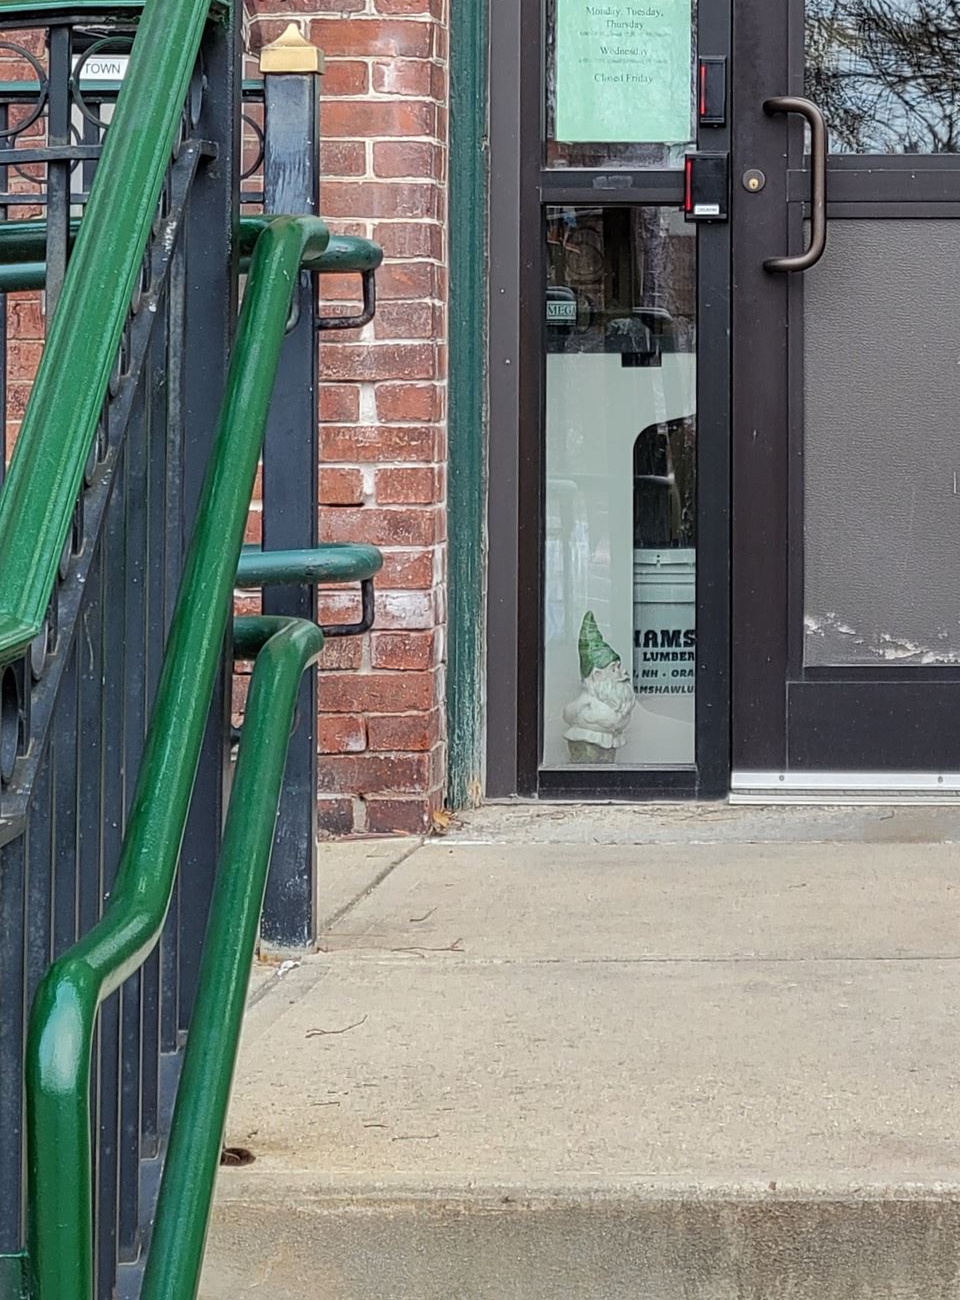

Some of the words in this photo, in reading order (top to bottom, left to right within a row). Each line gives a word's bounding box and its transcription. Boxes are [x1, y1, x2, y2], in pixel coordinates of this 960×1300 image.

[626, 6, 664, 18] Tuesday,
[606, 19, 644, 30] Thursday
[86, 63, 121, 74] TOWN
[626, 73, 654, 84] Friday
[643, 652, 695, 662] LUMBER
[642, 669, 659, 678] NH
